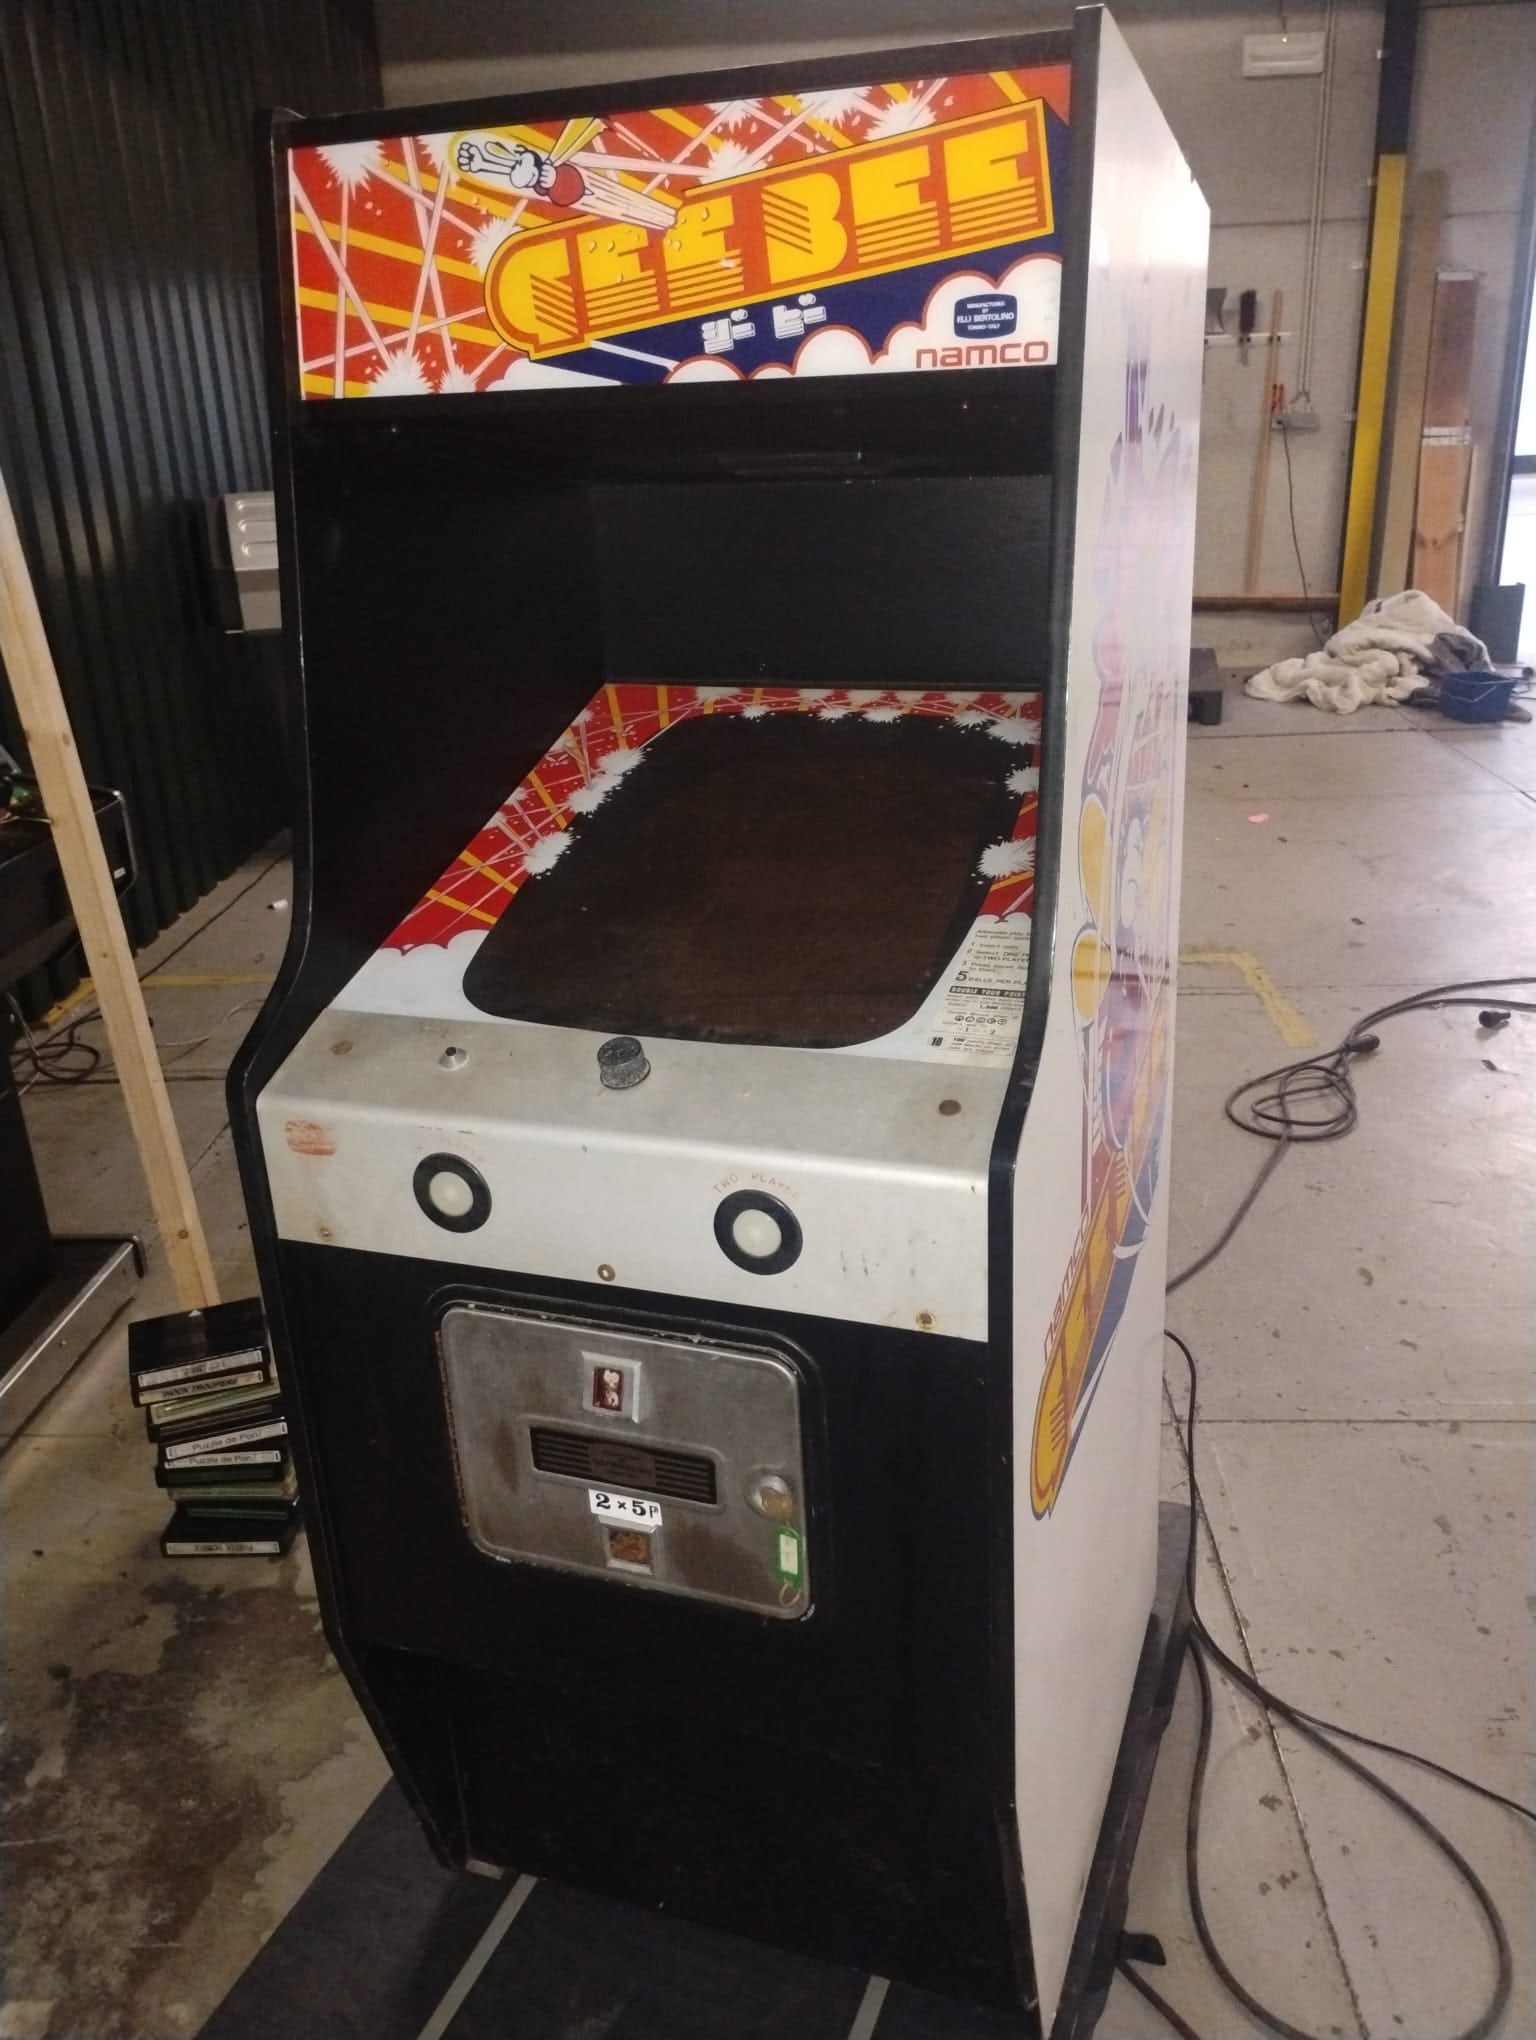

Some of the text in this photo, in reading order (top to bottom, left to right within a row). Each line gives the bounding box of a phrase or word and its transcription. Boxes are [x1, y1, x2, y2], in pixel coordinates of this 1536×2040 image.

[499, 119, 1038, 345] GEE BEE
[973, 311, 1015, 323] BERTOLINO
[916, 341, 1049, 369] namco
[955, 970, 969, 982] 5
[712, 1173, 738, 1194] TWO
[191, 1439, 223, 1452] Puzzle
[225, 1437, 237, 1445] de
[189, 1456, 219, 1465] Puzzle
[221, 1455, 233, 1463] de
[595, 1493, 611, 1510] 2
